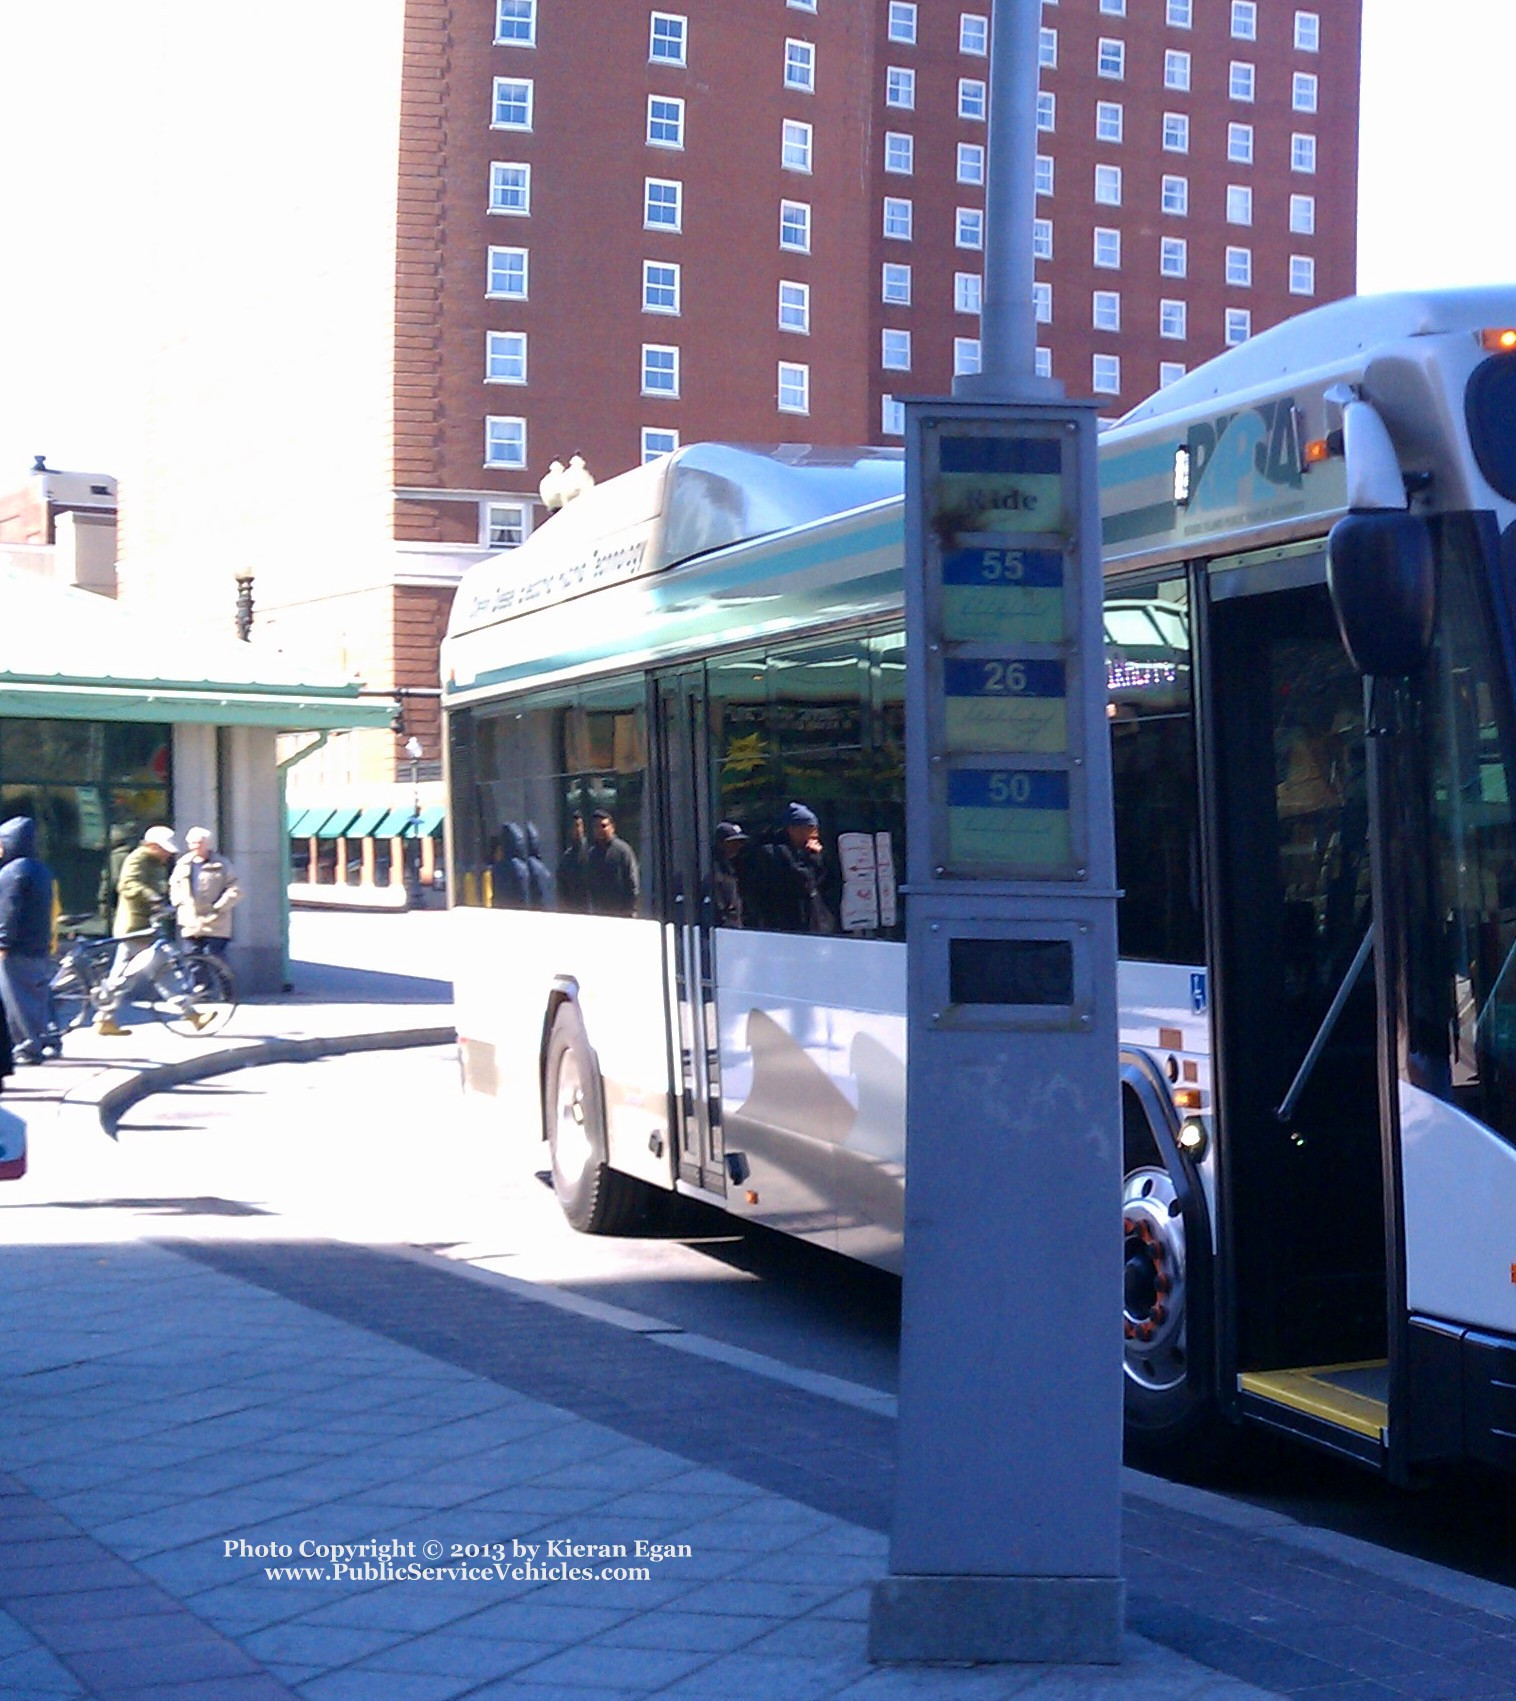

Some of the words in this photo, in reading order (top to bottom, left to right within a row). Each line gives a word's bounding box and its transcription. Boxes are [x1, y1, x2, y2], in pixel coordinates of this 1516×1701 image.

[981, 550, 1025, 581] 55
[983, 661, 1028, 692] 26
[988, 772, 1032, 803] 50
